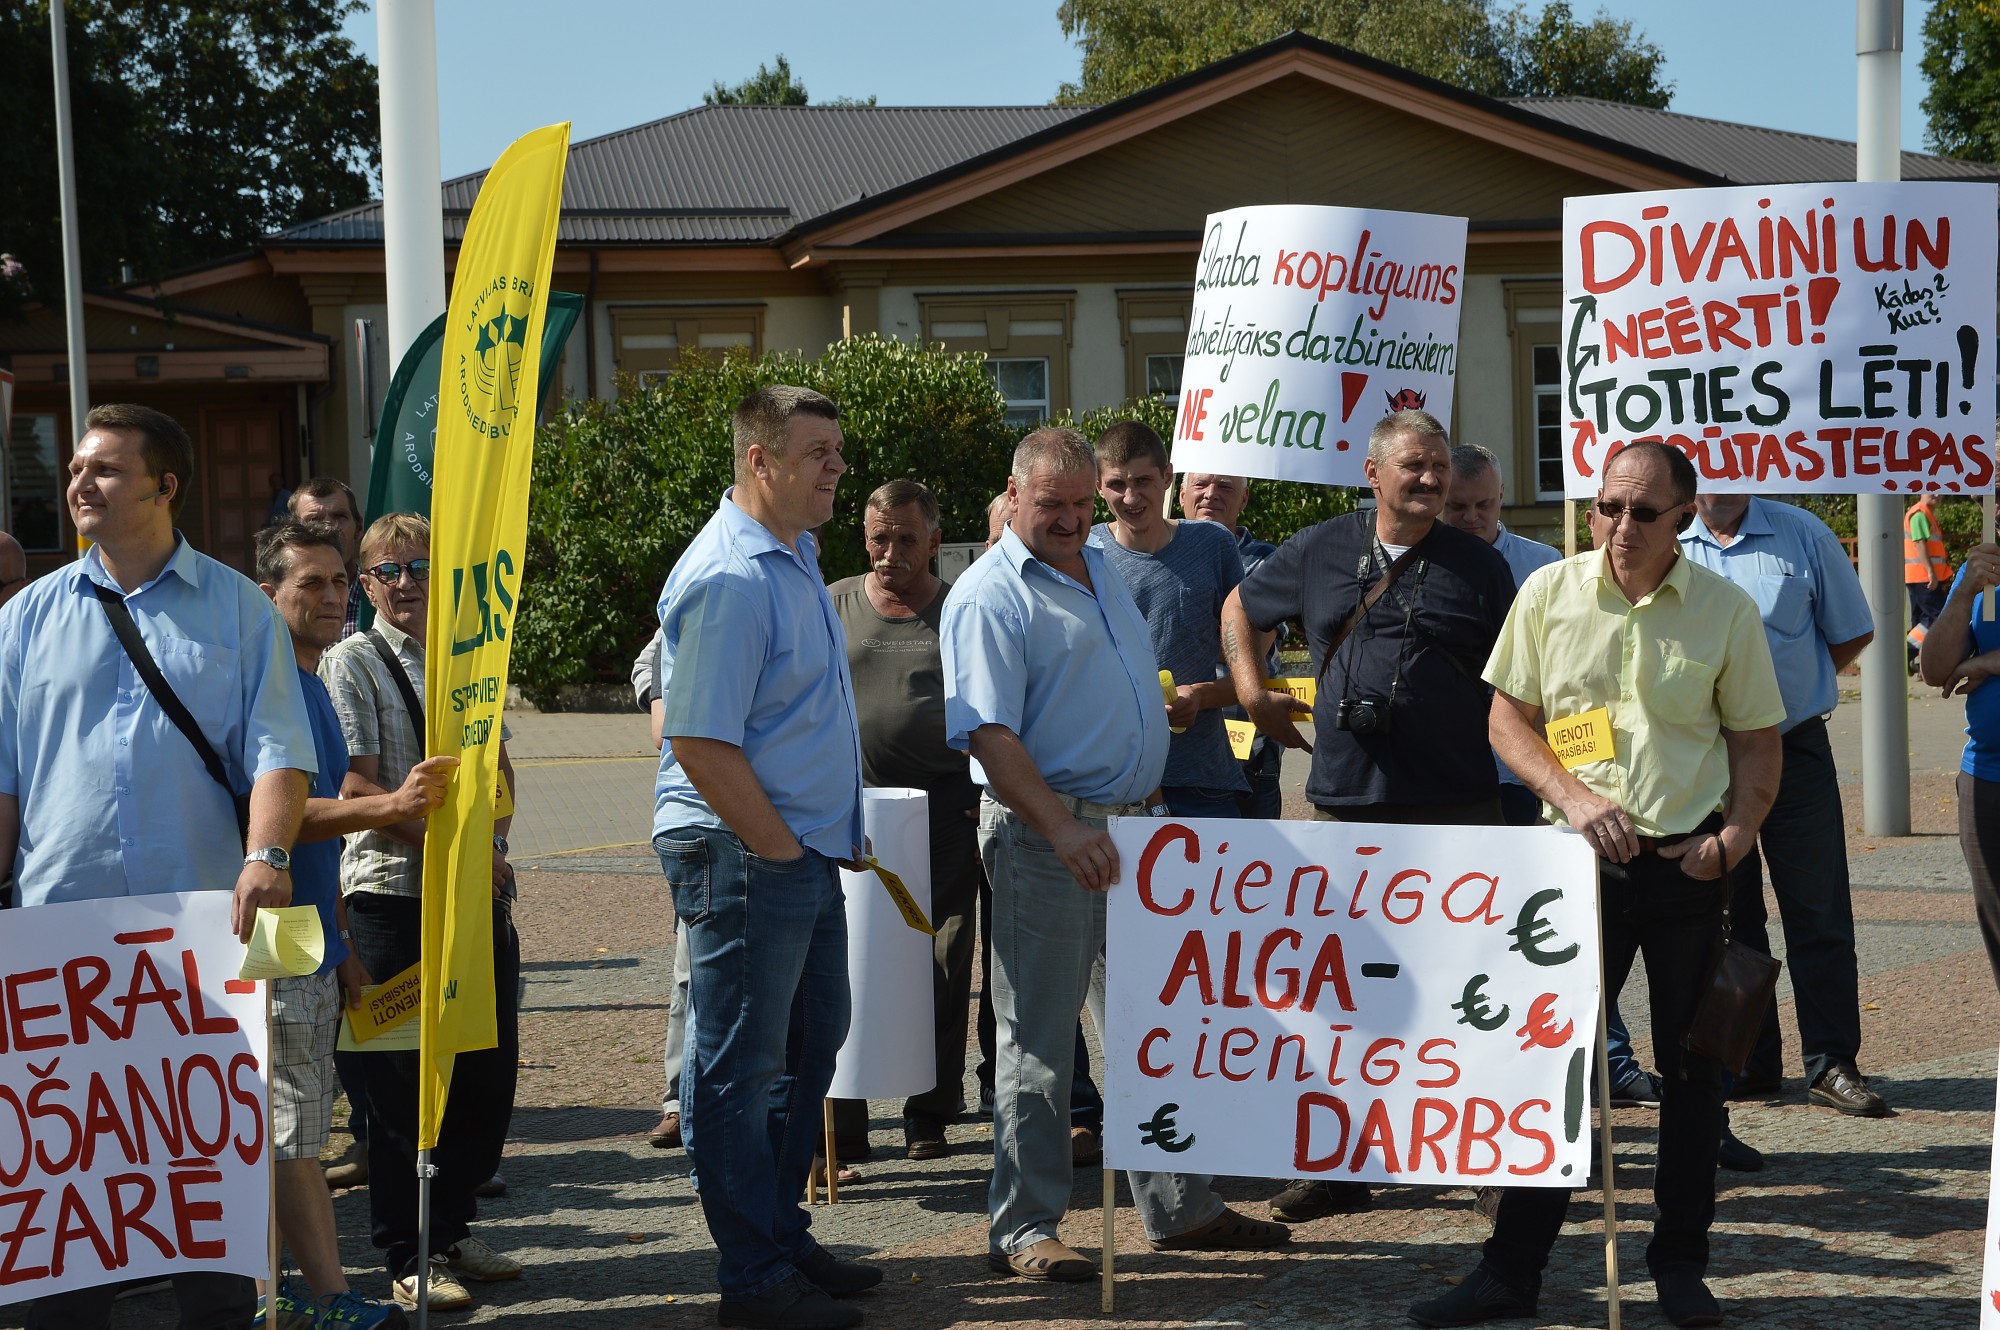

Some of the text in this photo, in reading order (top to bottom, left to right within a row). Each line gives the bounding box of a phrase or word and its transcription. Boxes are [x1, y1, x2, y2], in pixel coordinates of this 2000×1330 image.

[1580, 198, 1950, 294] DĪVAINI UN
[466, 276, 506, 332] LATVIJAS
[1603, 277, 1840, 363] NEĒRTI!
[1178, 388, 1213, 441] NE
[1579, 324, 1979, 434] TOTIES LĒTI!
[1553, 722, 1594, 746] VIENOTI
[1557, 741, 1597, 760] PRASĪBĀS!
[0, 928, 256, 1054] ERĀL-
